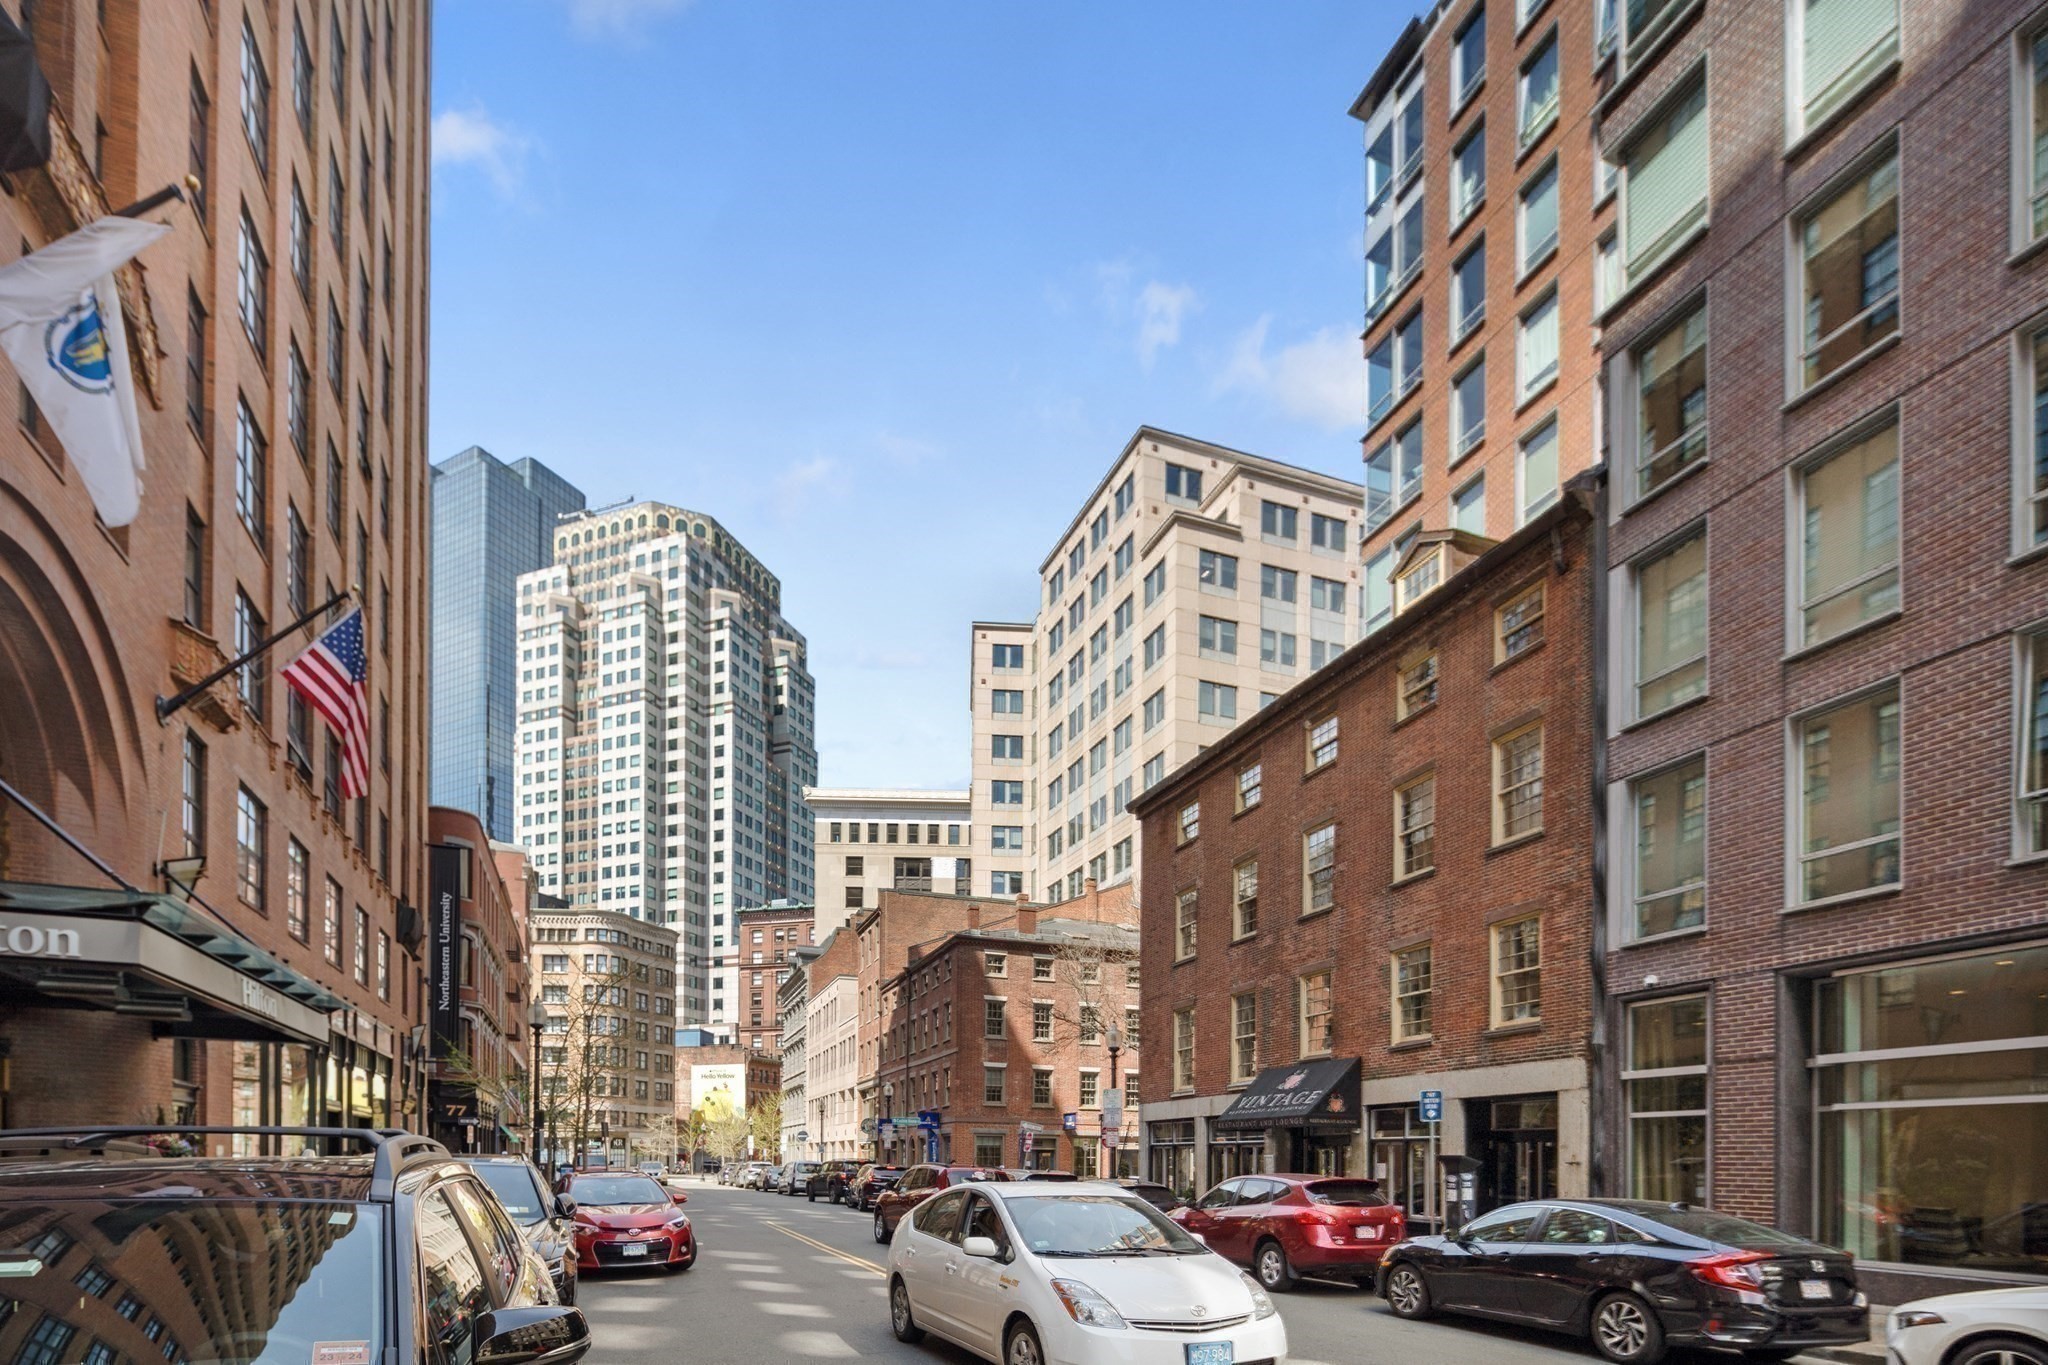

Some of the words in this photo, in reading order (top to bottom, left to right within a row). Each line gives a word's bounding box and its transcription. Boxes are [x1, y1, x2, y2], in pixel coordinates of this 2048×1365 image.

[439, 892, 453, 943] University
[439, 946, 450, 1011] Northeastern
[241, 976, 277, 1017] Hilton
[1237, 1090, 1323, 1109] VINTAGE
[445, 1104, 467, 1116] 77
[1218, 1120, 1257, 1129] RESTAURANT
[1260, 1119, 1273, 1127] AND
[1275, 1117, 1304, 1126] LOUNGE
[348, 1352, 362, 1360] 24
